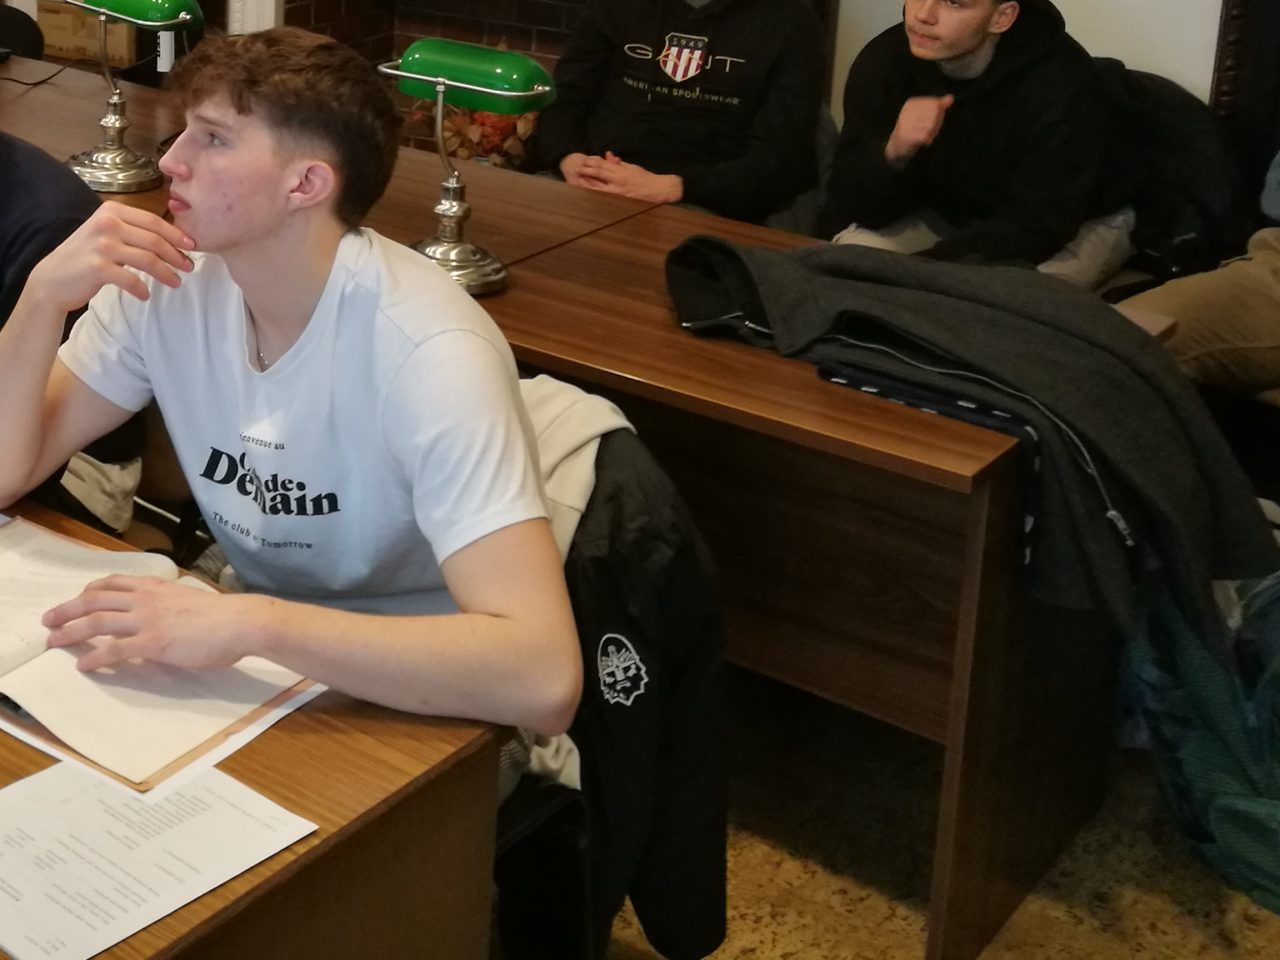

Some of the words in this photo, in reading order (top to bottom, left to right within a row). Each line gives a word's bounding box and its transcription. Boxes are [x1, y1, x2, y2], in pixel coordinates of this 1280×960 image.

[623, 76, 669, 94] AMERIAN
[213, 512, 229, 527] The
[231, 523, 251, 537] club
[260, 538, 313, 549] Tomorrow
